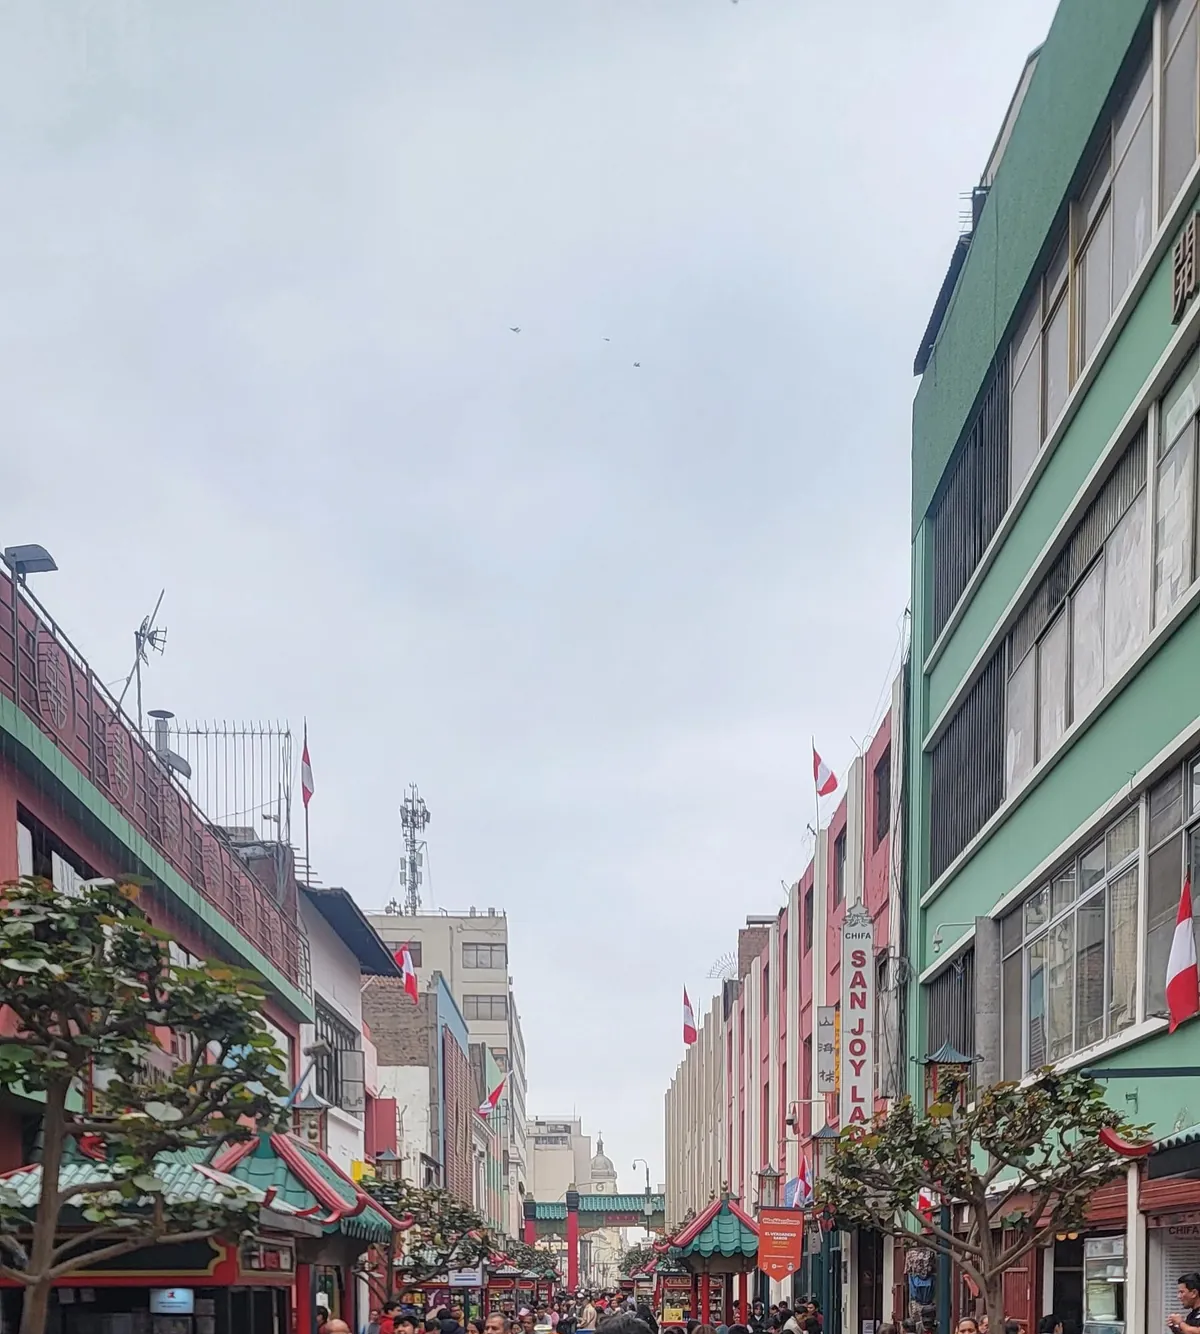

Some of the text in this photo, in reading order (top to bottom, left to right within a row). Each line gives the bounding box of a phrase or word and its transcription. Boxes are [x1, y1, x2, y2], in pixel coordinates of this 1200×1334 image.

[845, 932, 871, 940] CHIFA
[849, 950, 867, 1009] SAN
[848, 1018, 867, 1076] JOY
[1168, 1225, 1199, 1235] CHIFA
